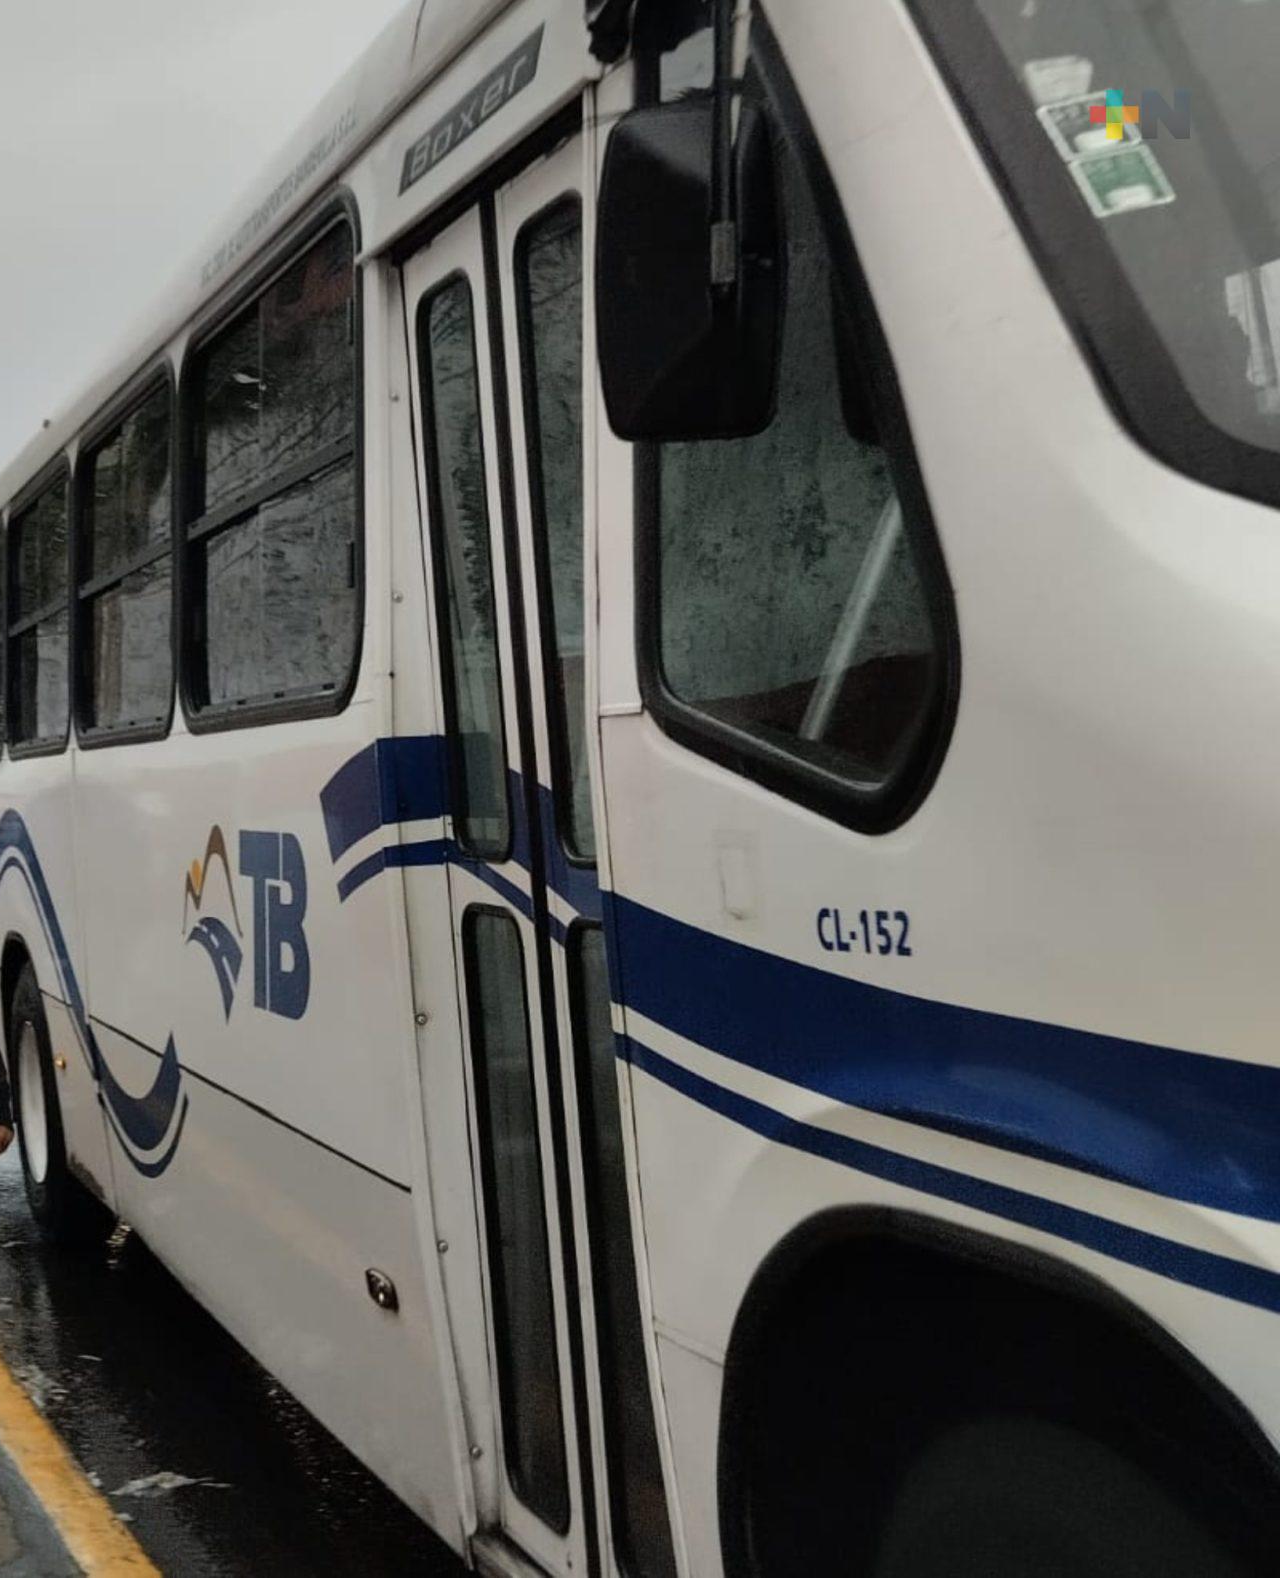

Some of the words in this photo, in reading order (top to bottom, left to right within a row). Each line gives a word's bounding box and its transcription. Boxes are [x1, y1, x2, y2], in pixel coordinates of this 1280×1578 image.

[408, 53, 529, 181] Boxer
[238, 829, 311, 1021] TB
[816, 907, 913, 957] CL-152
